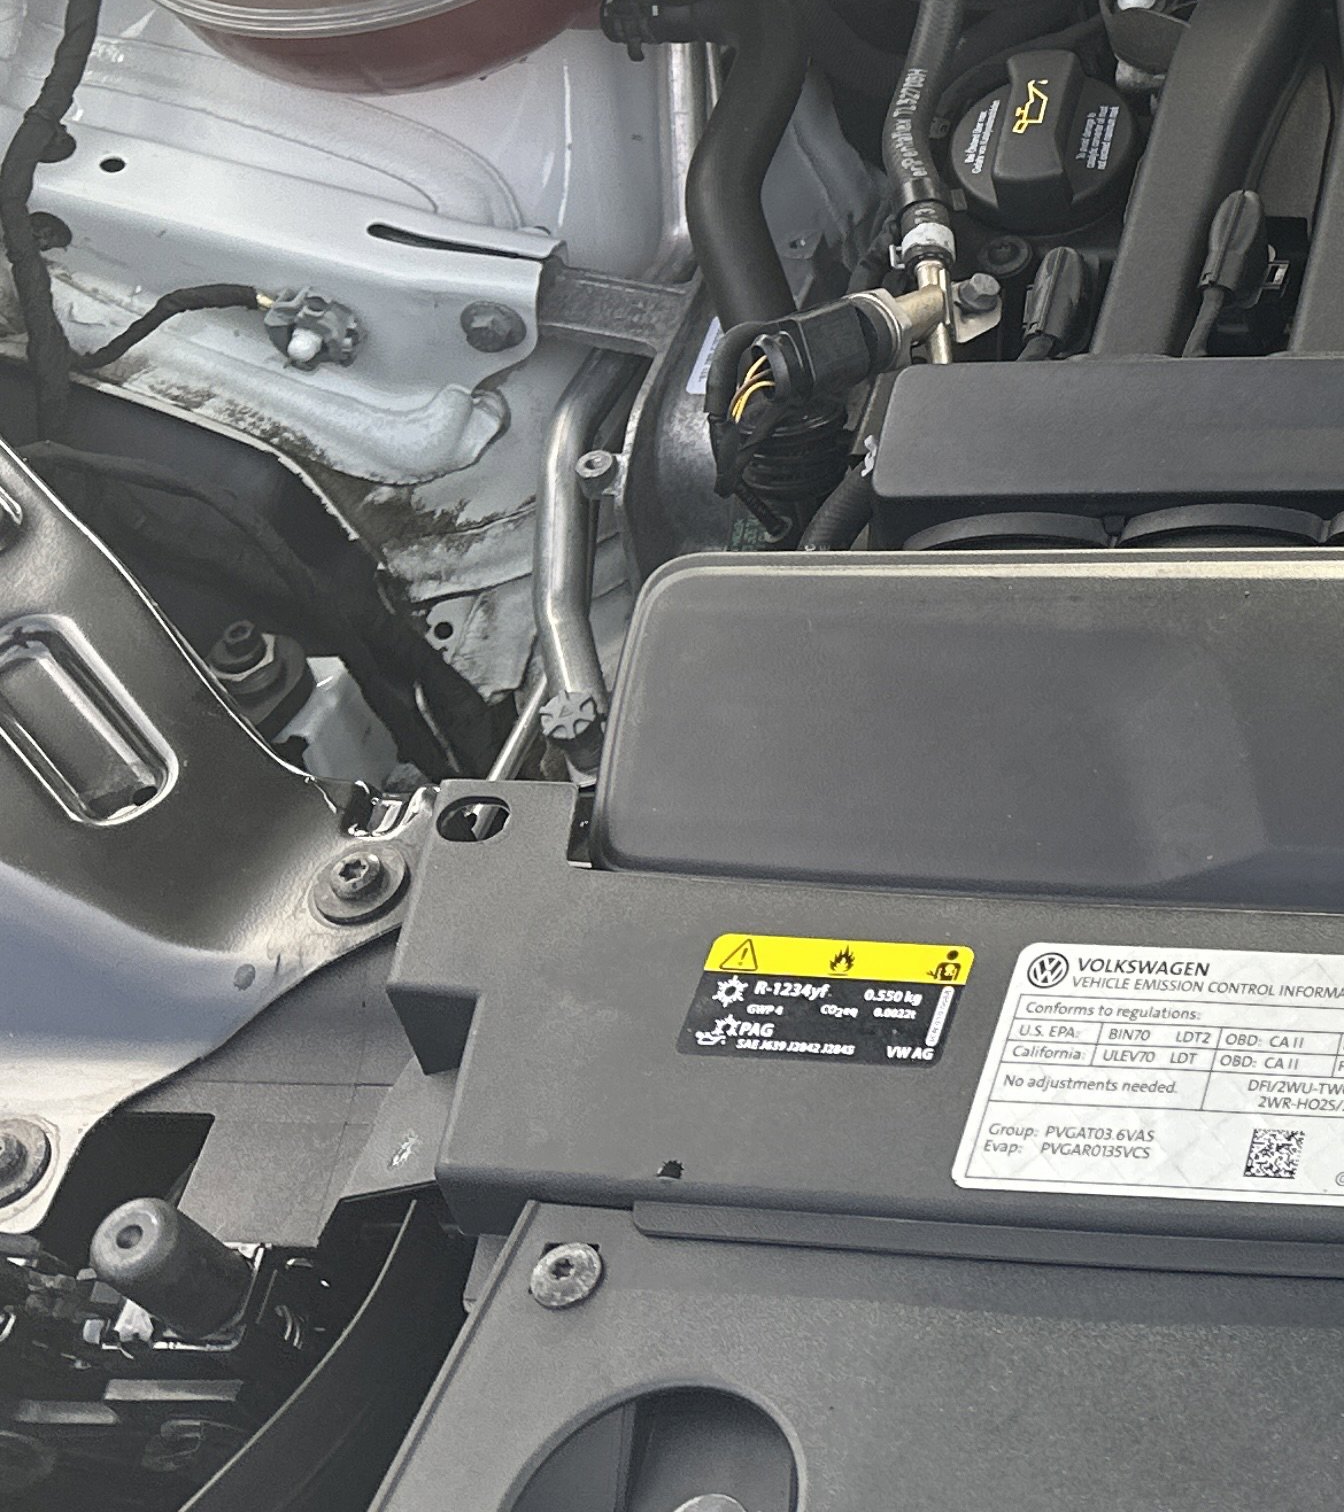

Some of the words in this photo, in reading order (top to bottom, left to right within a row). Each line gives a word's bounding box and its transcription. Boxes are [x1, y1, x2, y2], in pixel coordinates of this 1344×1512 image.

[1078, 957, 1210, 977] VOLKSWAGEN
[754, 981, 830, 1000] R-1234yf
[864, 989, 903, 1002] 0.550
[904, 991, 922, 1006] kg
[1072, 976, 1129, 989] VEHICLE
[1134, 979, 1204, 993] EMISSION
[1208, 981, 1275, 996] CONTROL
[1026, 1001, 1095, 1016] Conforms
[1098, 1003, 1113, 1017] to
[1116, 1005, 1201, 1021] regulations:
[739, 1022, 774, 1037] PAG
[1019, 1024, 1044, 1038] U.S.
[1049, 1026, 1080, 1038] EPA:
[1108, 1028, 1151, 1041] BIN70
[1175, 1031, 1211, 1044] LDT2
[1225, 1033, 1262, 1046] OBD:
[1269, 1036, 1289, 1048] CA
[887, 1046, 912, 1058] VW
[911, 1048, 934, 1060] AG
[1012, 1045, 1086, 1060] California:
[1102, 1049, 1155, 1063] ULEV70
[1169, 1052, 1198, 1064] LDT
[1220, 1055, 1257, 1068] OBD:
[1264, 1057, 1285, 1070] CA
[1003, 1075, 1024, 1087] No
[1028, 1076, 1118, 1092] adjustments
[1121, 1080, 1178, 1094] needed.
[989, 1124, 1038, 1139] Group:
[1045, 1125, 1155, 1142] PVGAT03.6VAS
[983, 1140, 1023, 1156] Evap:
[1040, 1142, 1151, 1159] PVGAR0135VCS
